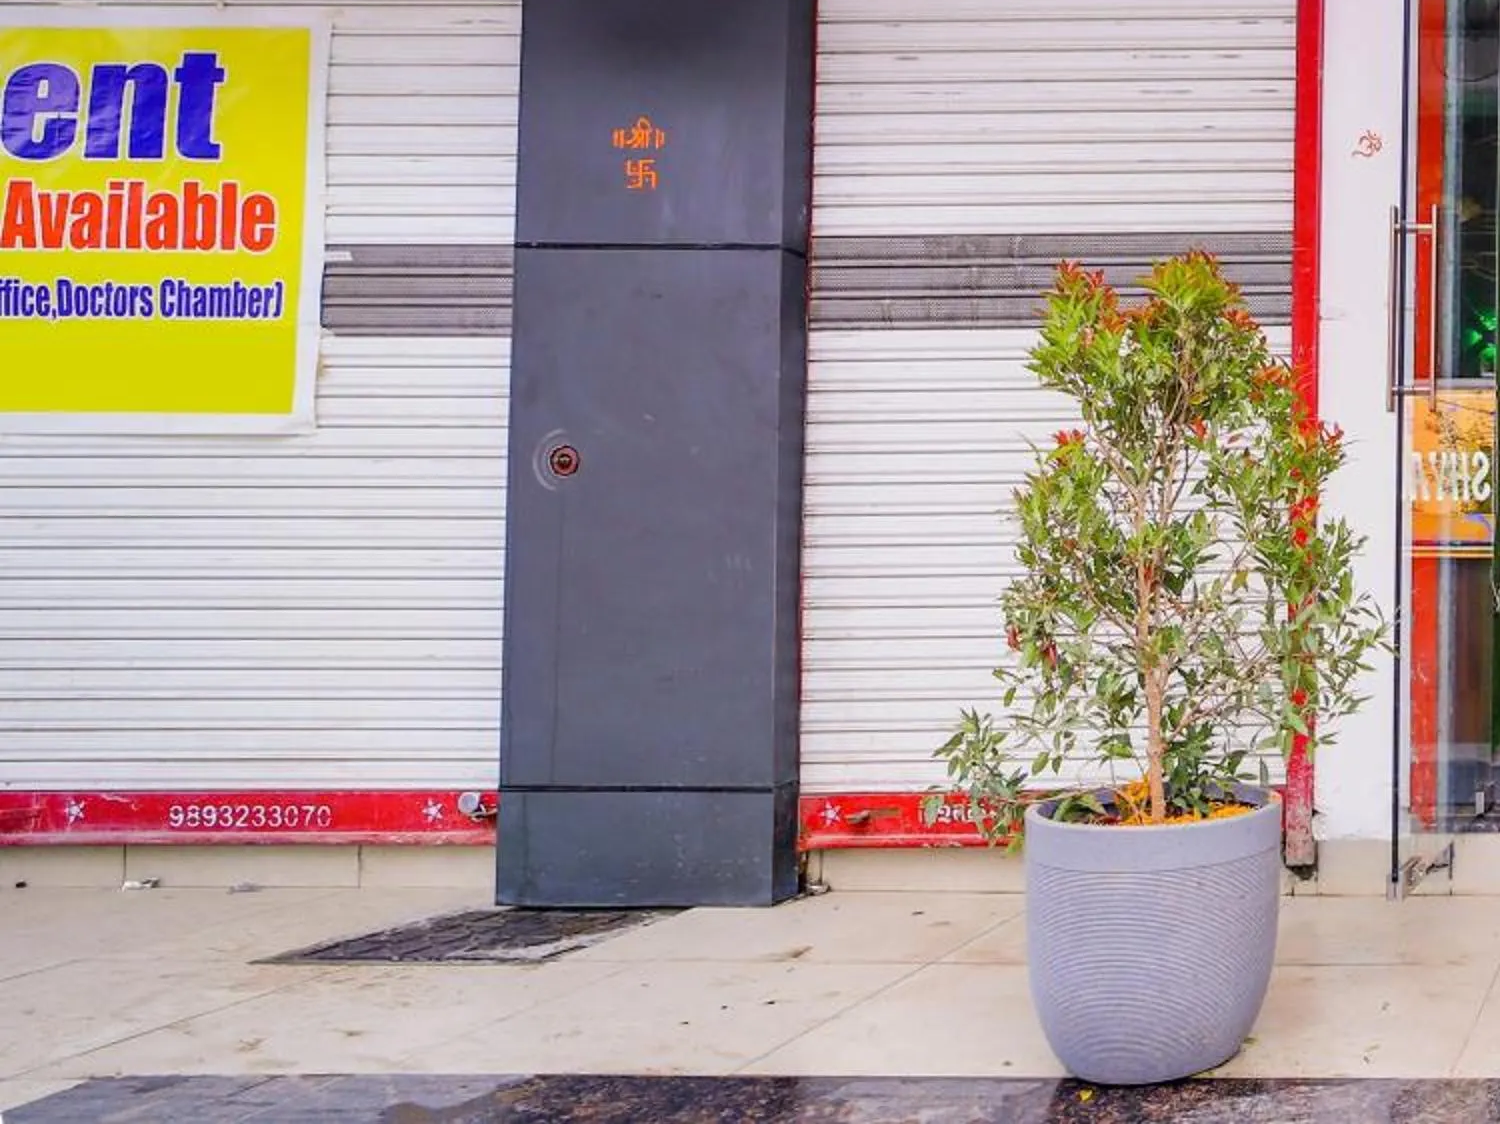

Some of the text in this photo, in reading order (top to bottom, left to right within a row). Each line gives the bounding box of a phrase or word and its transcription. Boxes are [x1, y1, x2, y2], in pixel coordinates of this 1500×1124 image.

[1, 52, 224, 160] ent
[0, 180, 276, 252] Available
[169, 805, 332, 827] 9893233070
